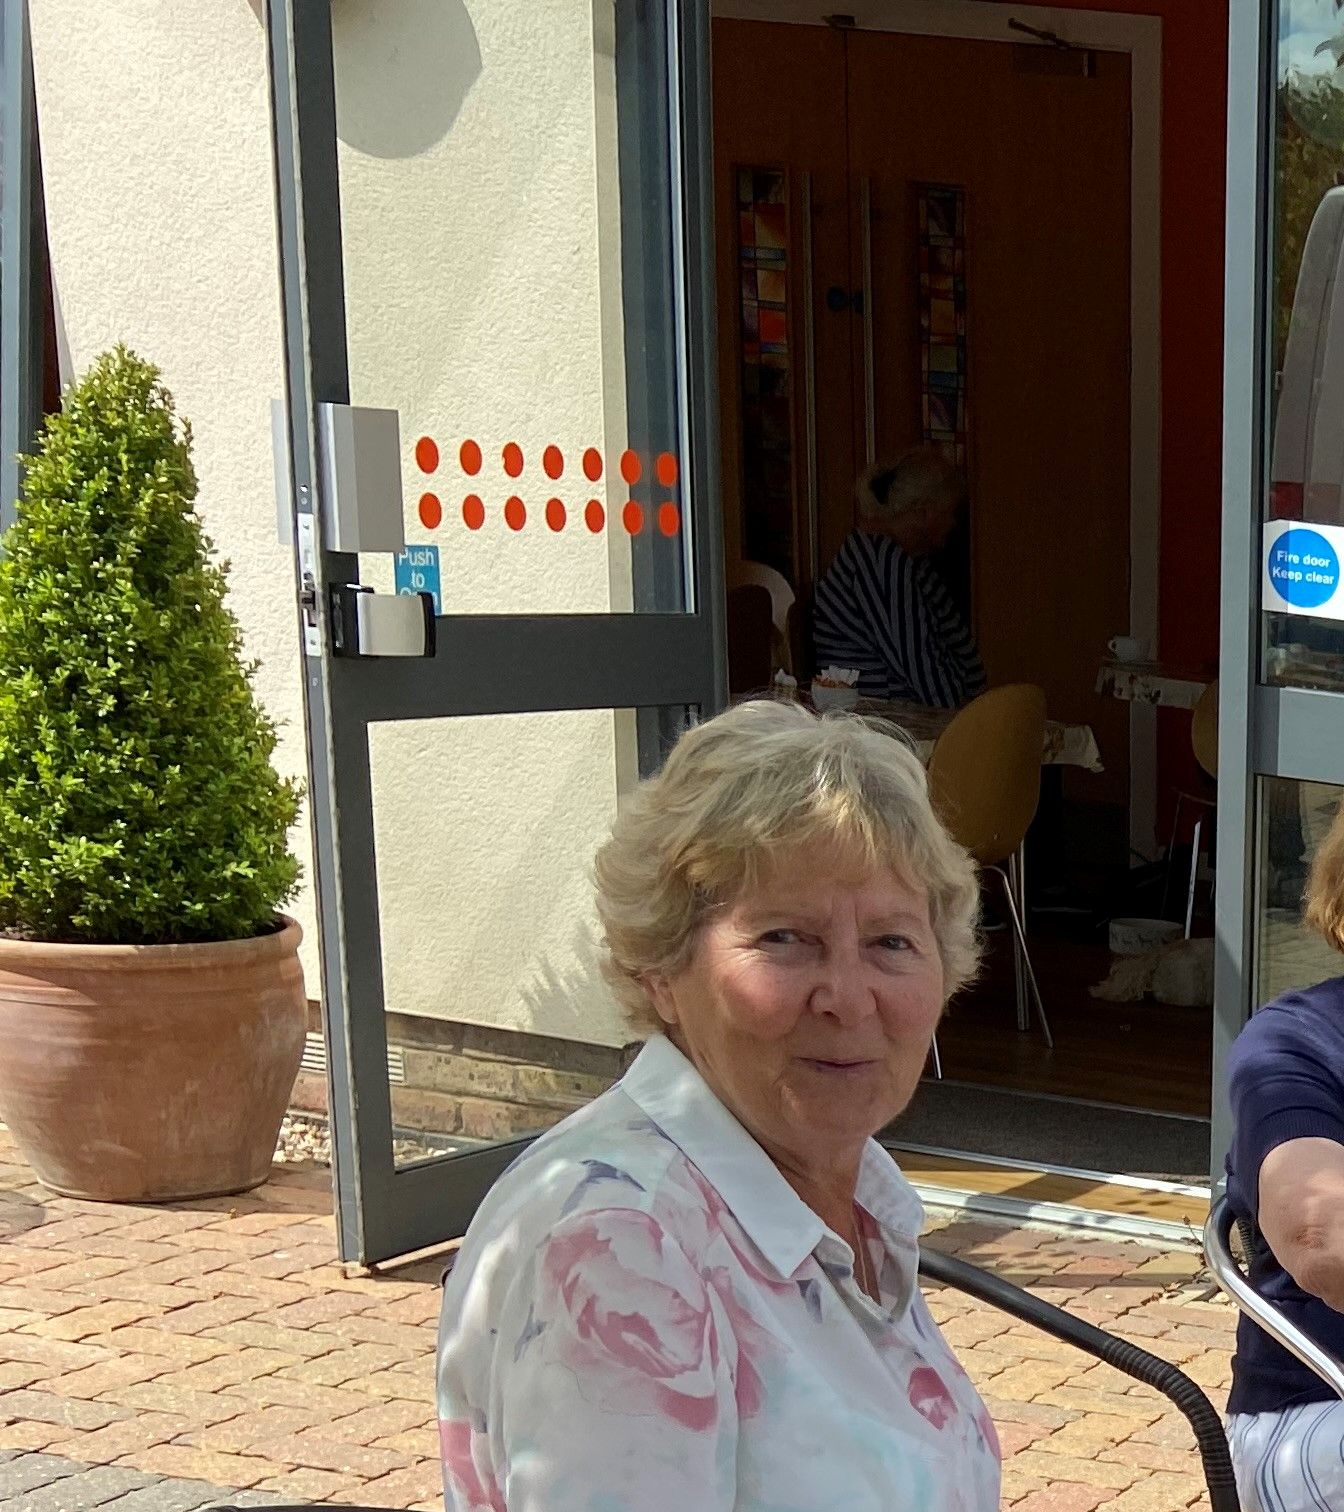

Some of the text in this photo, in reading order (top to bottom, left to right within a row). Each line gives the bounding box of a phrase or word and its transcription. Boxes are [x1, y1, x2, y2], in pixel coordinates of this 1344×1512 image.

[1277, 551, 1331, 568] Fire door
[411, 570, 425, 589] to
[1272, 566, 1335, 585] Keep clear
